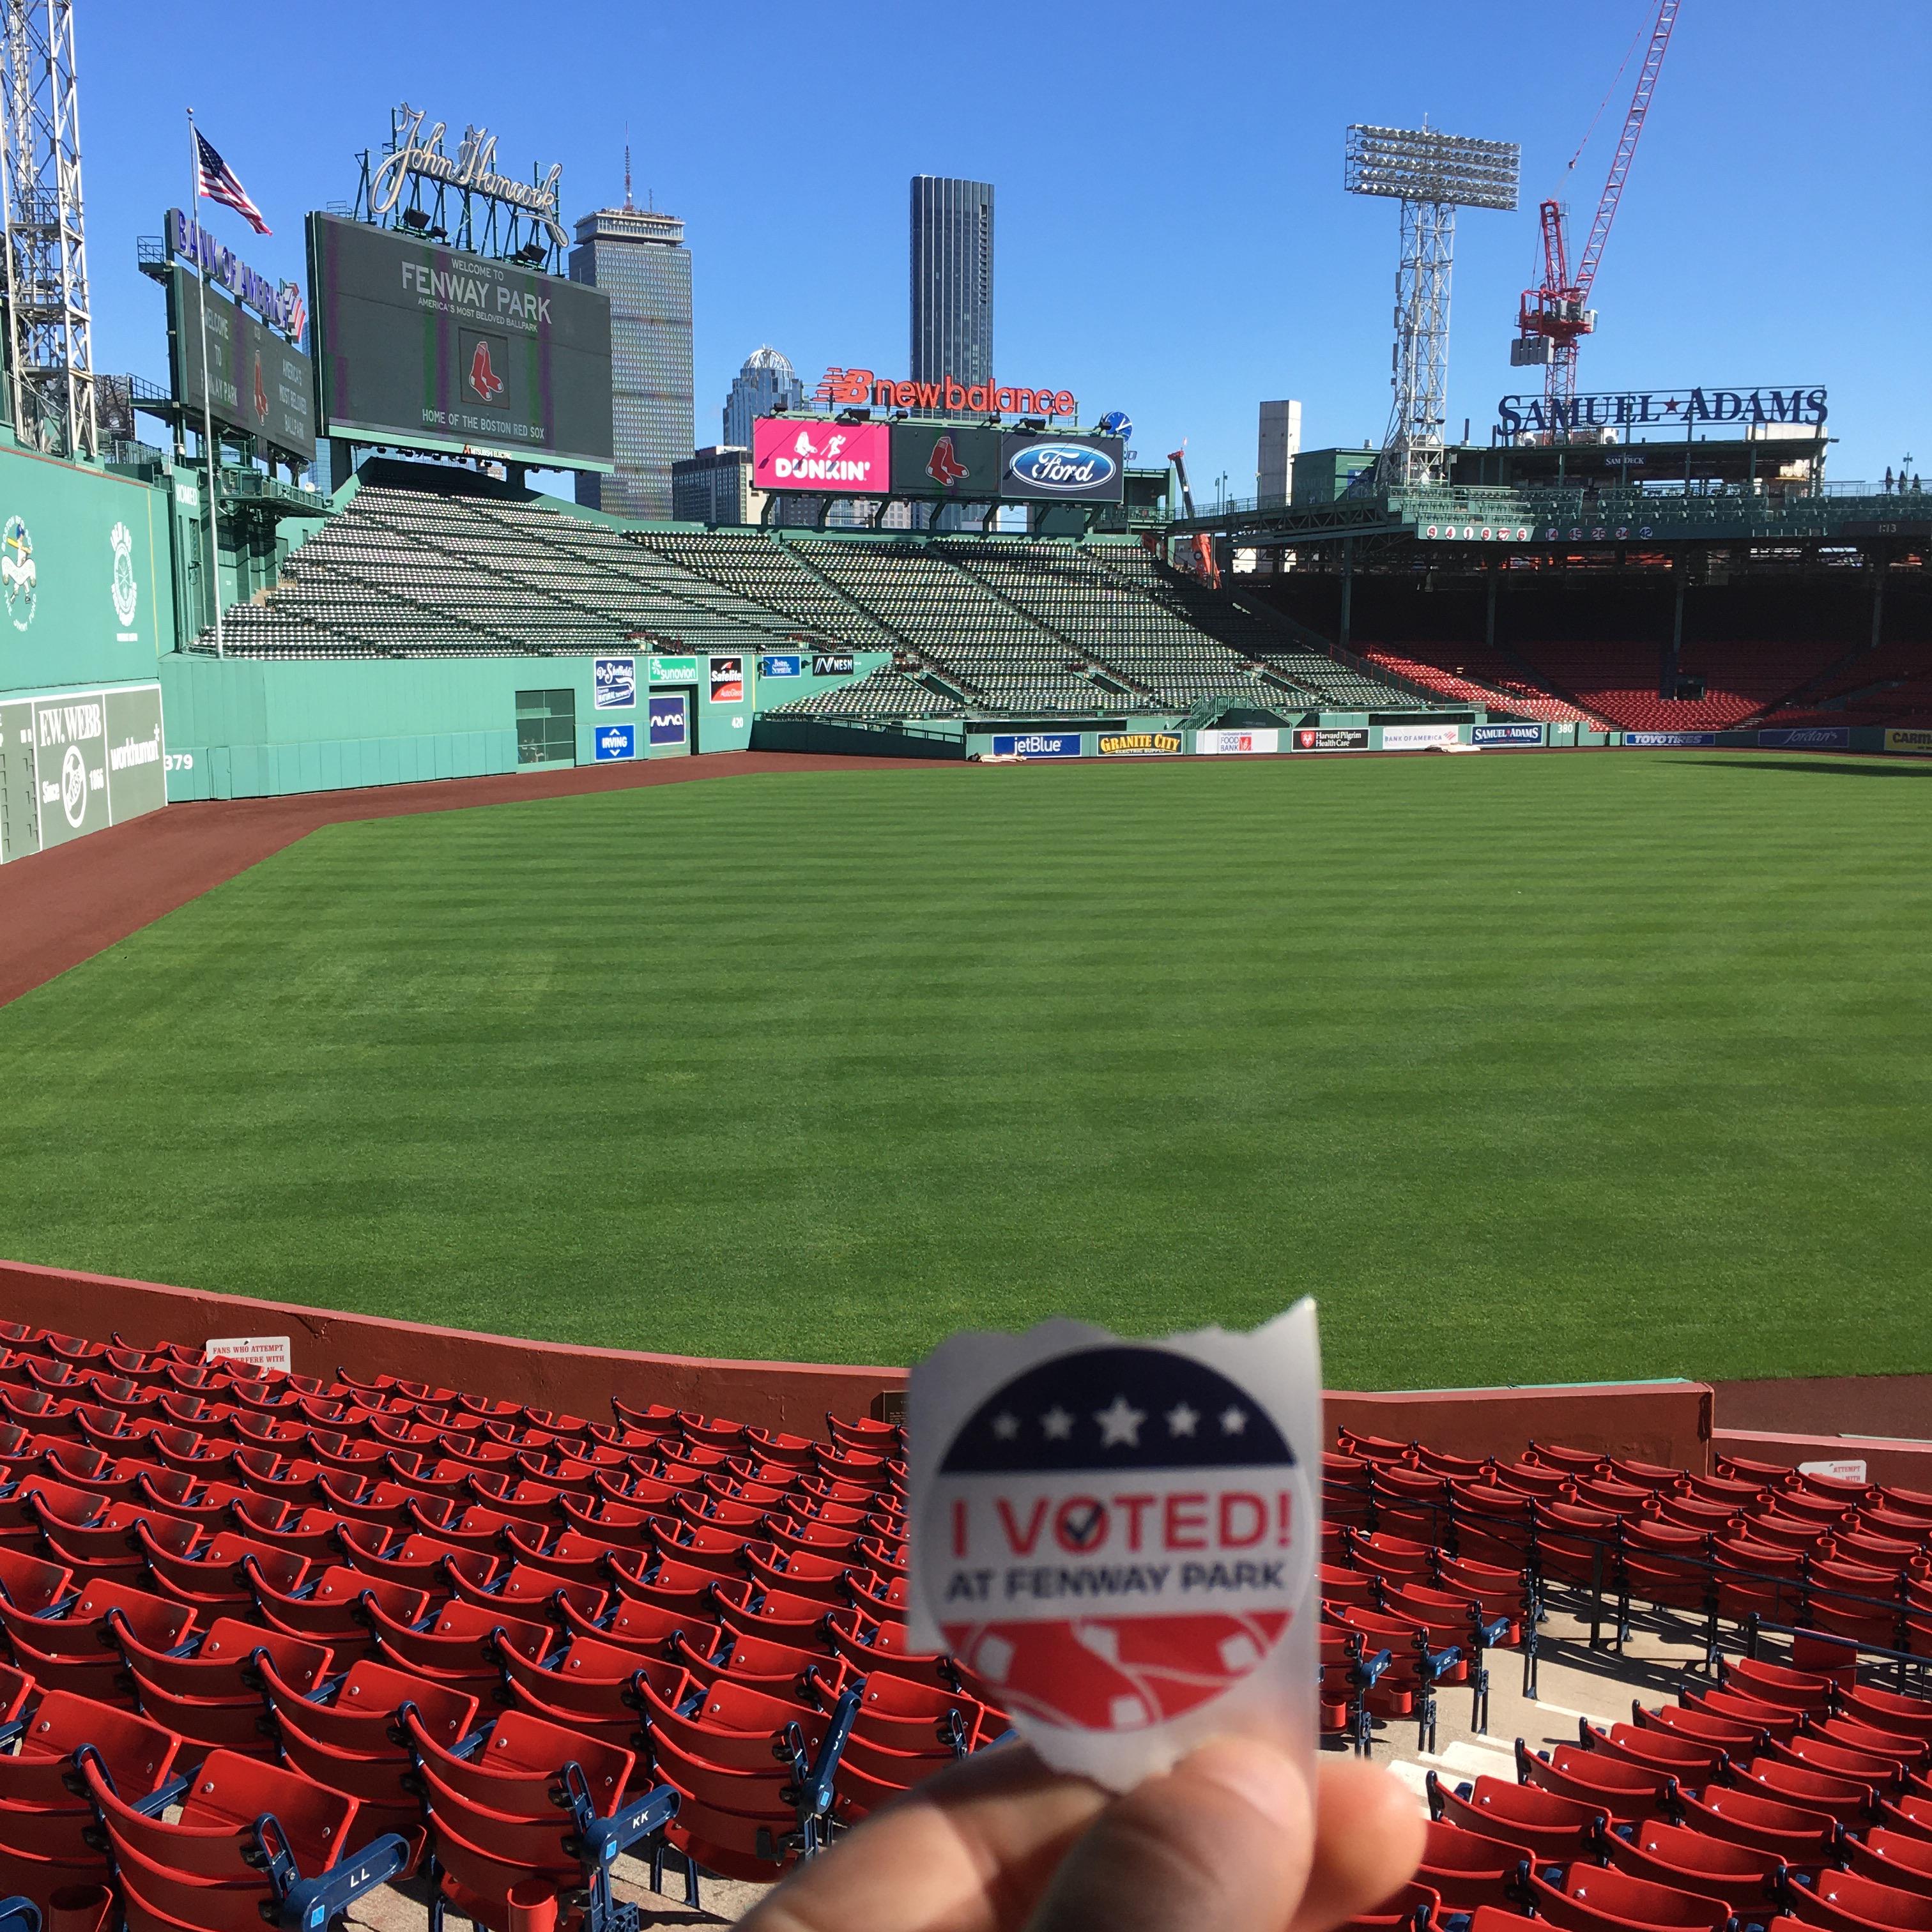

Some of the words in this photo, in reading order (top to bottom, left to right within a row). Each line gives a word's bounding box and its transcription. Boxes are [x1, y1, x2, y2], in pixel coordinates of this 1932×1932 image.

[369, 102, 455, 213] John
[453, 124, 569, 248] Hancock
[613, 219, 669, 229] PRUDENTIAL
[171, 208, 218, 278] BANK
[234, 261, 289, 331] AMERICA
[451, 258, 491, 279] WELCOME
[493, 269, 504, 281] TO
[402, 261, 489, 308] FENWAY
[497, 286, 552, 325] PARK
[204, 306, 229, 341] WELCOME
[418, 297, 455, 314] AMERICA'S
[456, 306, 474, 318] MOST
[476, 312, 505, 325] BELOVED
[506, 318, 538, 332] BALLPARK
[214, 344, 222, 367] TO
[224, 381, 238, 407] PARK
[876, 378, 941, 410] new
[946, 374, 1075, 416] balance
[1497, 394, 1661, 437] SAMUEL
[1681, 387, 1828, 425] ADAMS
[422, 409, 445, 424] HOME
[448, 413, 459, 425] OF
[463, 415, 479, 429] THE
[480, 418, 511, 434] BOSTON
[514, 424, 528, 436] RED
[530, 427, 544, 440] SOX
[775, 457, 870, 481] DUNKIN'
[1031, 448, 1094, 482] Ford
[1606, 457, 1621, 466] SAM
[1624, 456, 1645, 464] DECK
[1878, 524, 1897, 533] 1:13
[661, 666, 696, 680] sunovion
[834, 659, 852, 670] NESN
[711, 670, 742, 682] Safelite
[65, 703, 102, 742] WEBB
[651, 714, 684, 727] nuna
[732, 717, 744, 728] 420
[1558, 724, 1573, 733] 380
[602, 737, 627, 748] IRVING
[1100, 735, 1151, 753] GRANITE
[1154, 733, 1181, 752] CITY
[1339, 732, 1361, 740] Pilgrim
[1475, 728, 1506, 740] SAMUEL
[1510, 727, 1538, 739] ADAMS
[1635, 735, 1667, 744] TOYO
[1667, 735, 1703, 744] TIRES
[1784, 730, 1837, 745] Jordan's
[111, 737, 160, 771] workhuman
[1014, 737, 1062, 755] jetBlue
[164, 755, 194, 771] 379
[42, 781, 60, 804] Since
[251, 1344, 284, 1353] ATTEMPT
[951, 1496, 969, 1558] I
[993, 1490, 1294, 1556] VOTED!
[945, 1567, 993, 1602] AT
[1004, 1562, 1169, 1599] FENWAY
[1179, 1560, 1285, 1591] PARK
[632, 1810, 649, 1828] KK
[350, 1868, 371, 1888] LL
